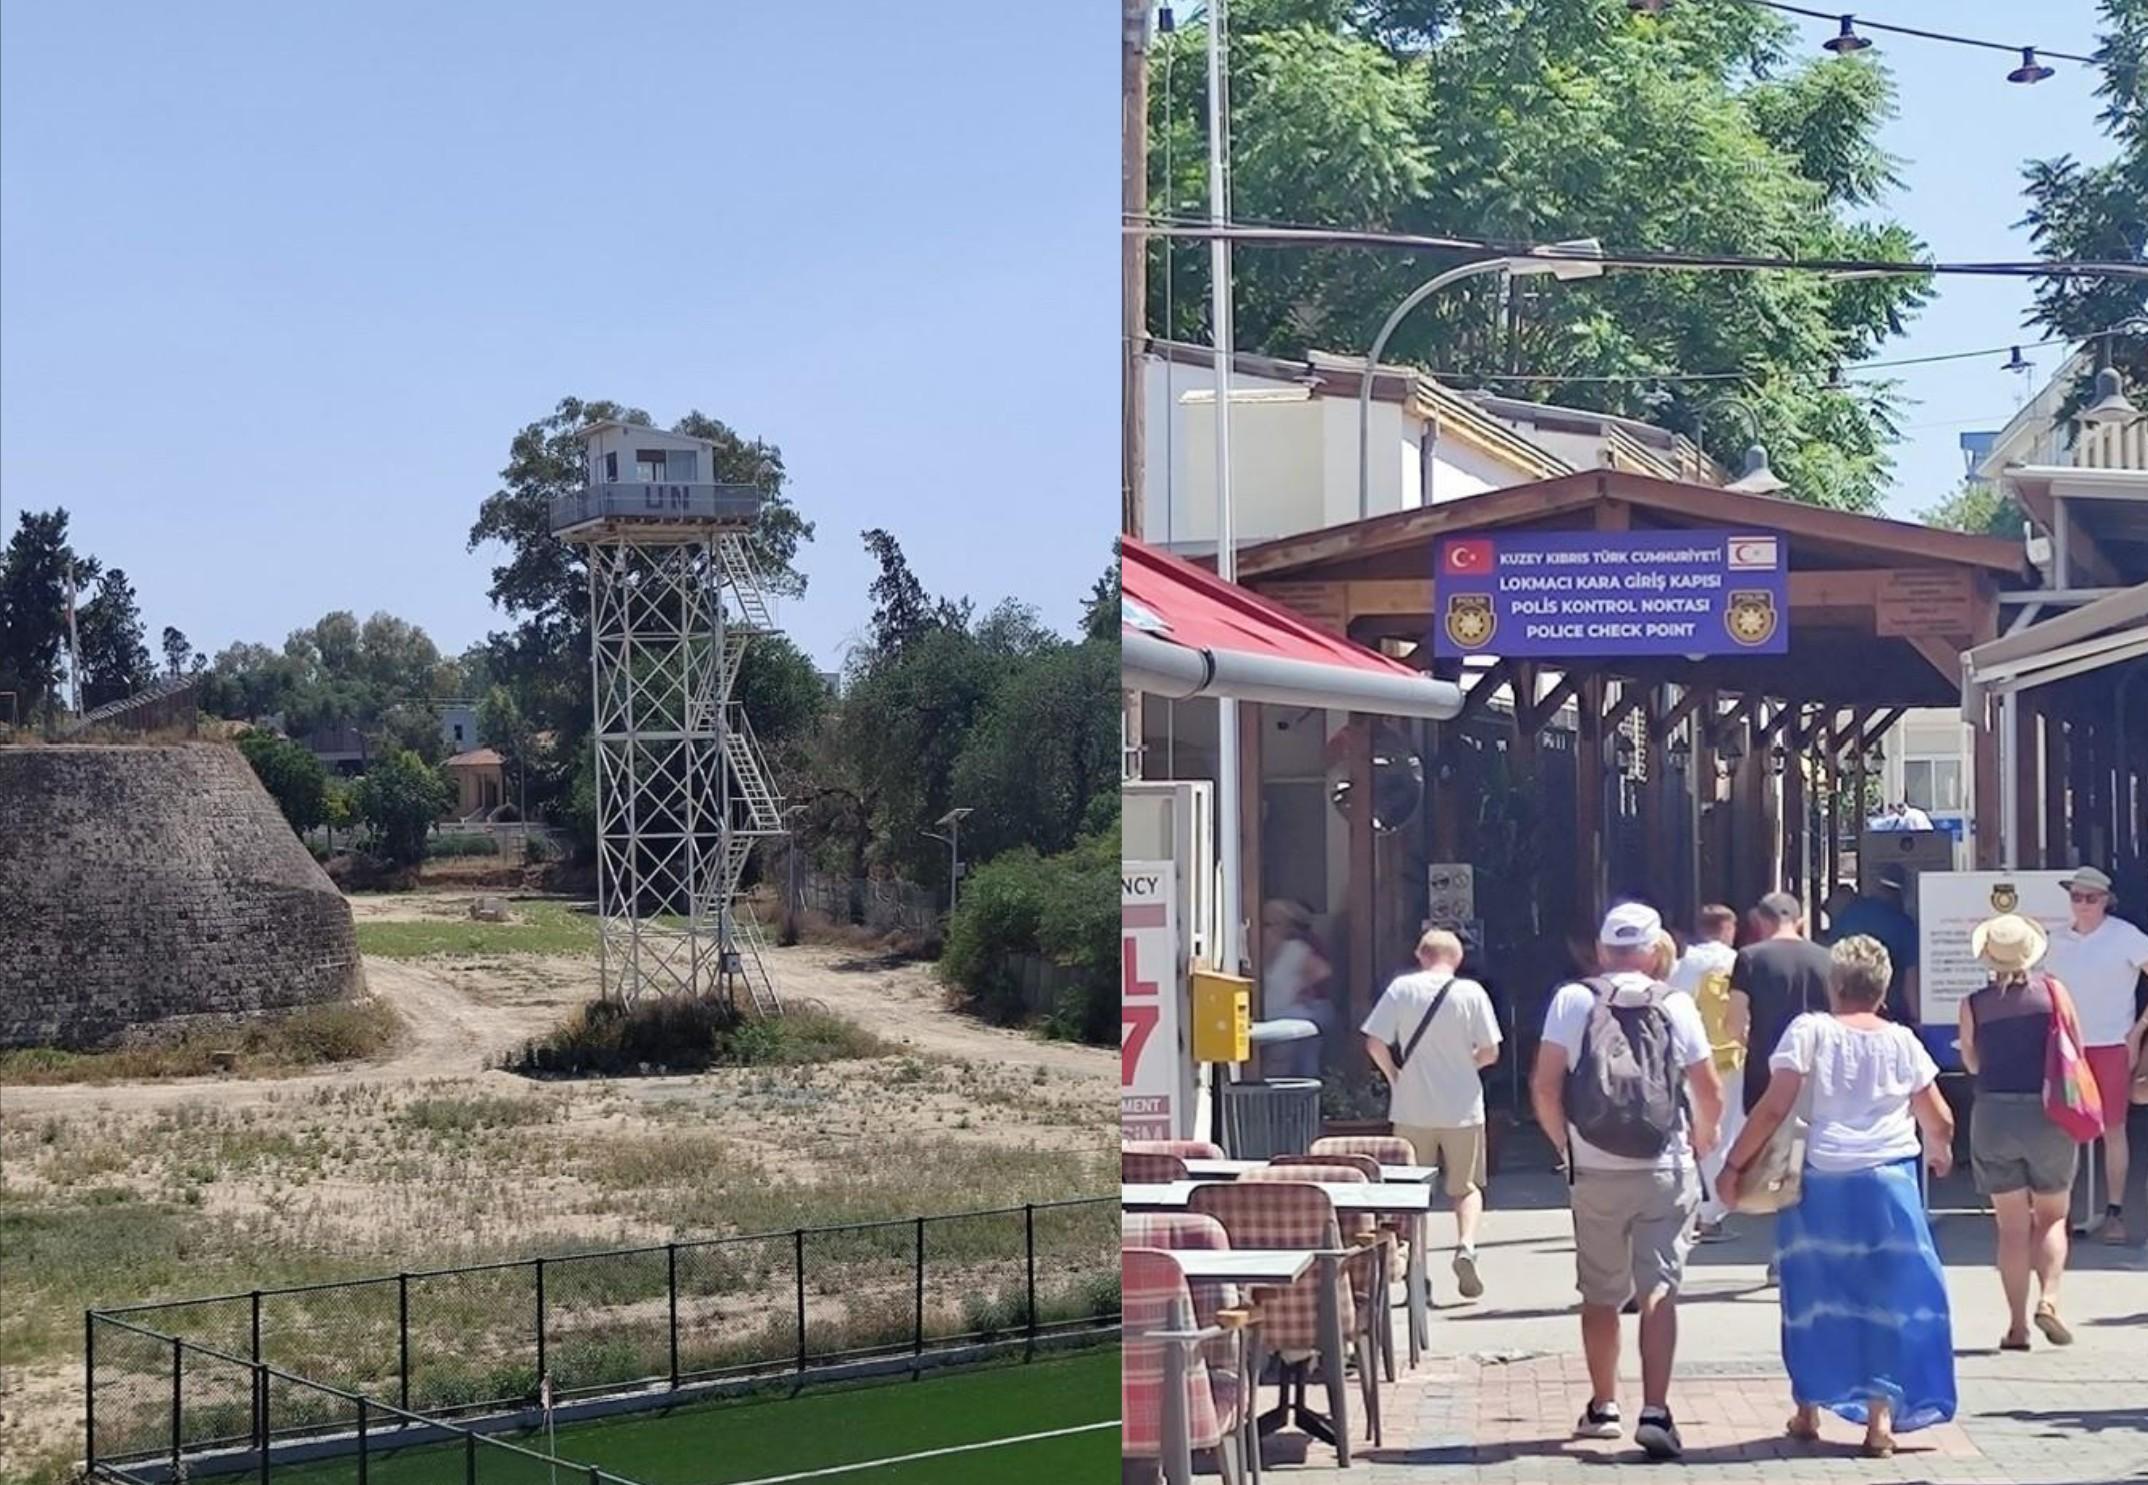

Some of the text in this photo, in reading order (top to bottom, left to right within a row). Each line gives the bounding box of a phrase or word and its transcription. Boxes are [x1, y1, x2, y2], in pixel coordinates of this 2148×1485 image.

[645, 485, 690, 509] UN
[1500, 547, 1721, 565] KUZEY KIBRIS TÜRK CUMHURİYETİ
[1500, 571, 1721, 592] LOKMACI KARA GİRİŞ KAPISI
[1511, 596, 1710, 614] POLİS KONTROL NOKTASI
[1526, 622, 1696, 638] POLICE CHECK POINT
[1124, 936, 1158, 996] L
[1121, 1005, 1159, 1086] 7
